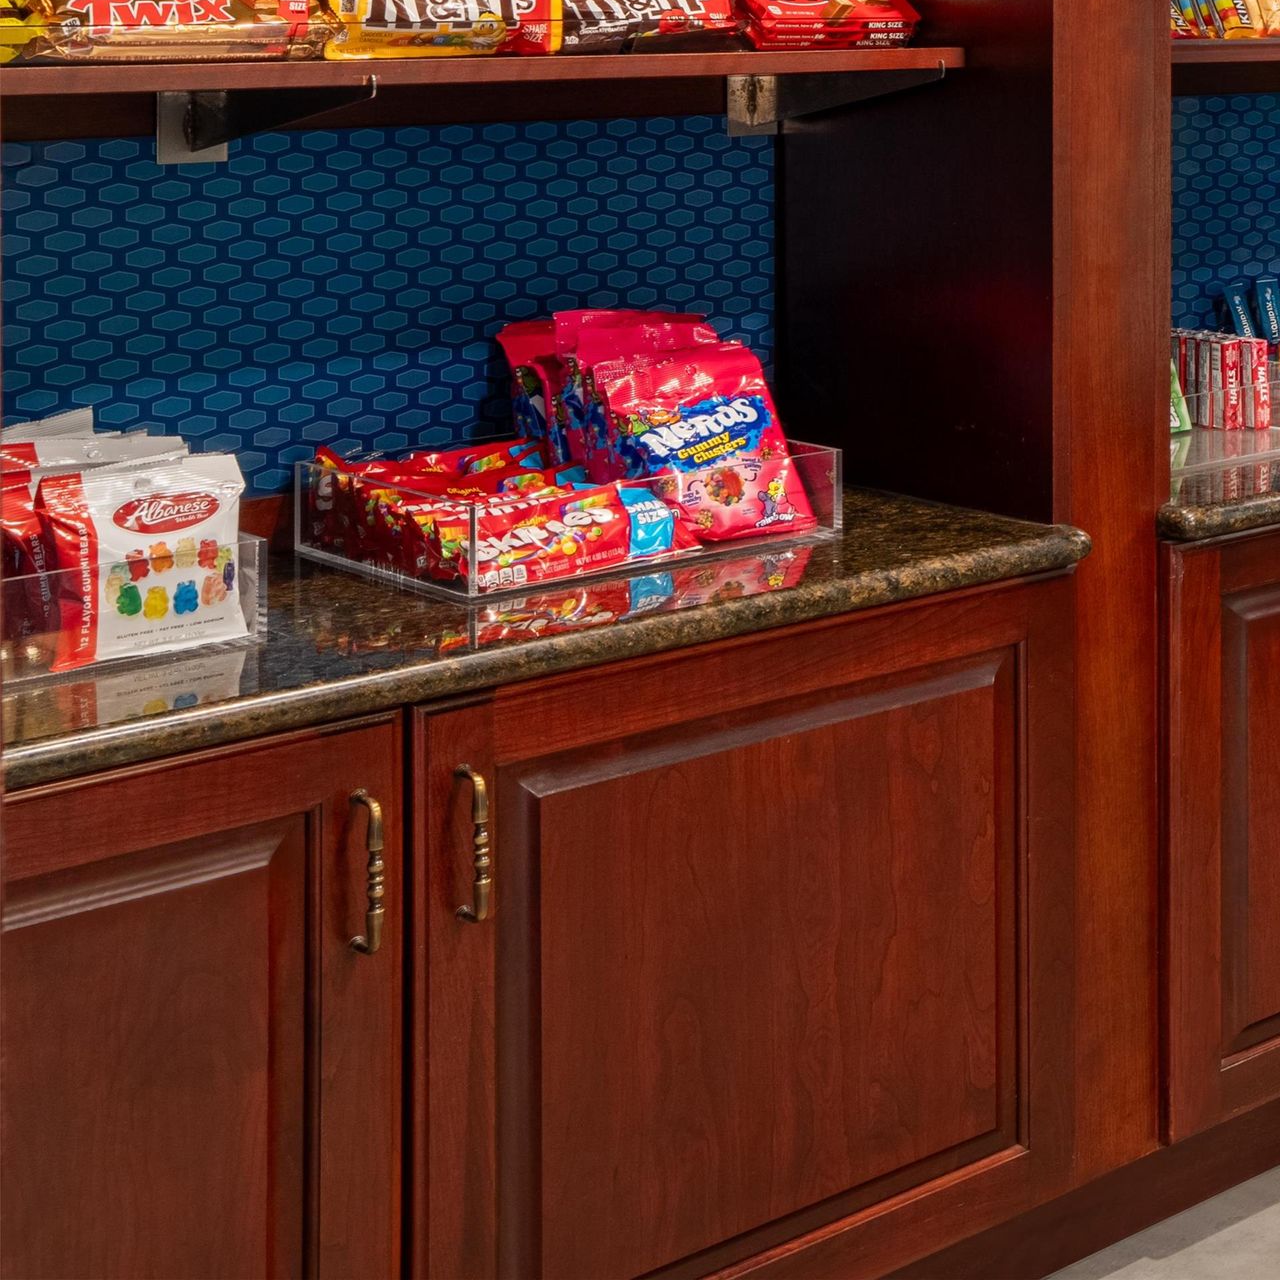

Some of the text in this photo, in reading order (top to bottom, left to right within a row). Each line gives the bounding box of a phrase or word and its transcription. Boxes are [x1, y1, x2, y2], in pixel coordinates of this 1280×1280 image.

[290, 1, 307, 10] SIZE
[522, 24, 548, 34] SHARE
[524, 32, 544, 43] SIZE
[1229, 371, 1237, 405] HALLS
[1257, 367, 1268, 401] HALLS
[678, 432, 729, 458] Gummy
[694, 437, 745, 463] Clusters
[132, 498, 211, 522] Albanese
[81, 523, 91, 633] FLAVOR GUMMI BEARS
